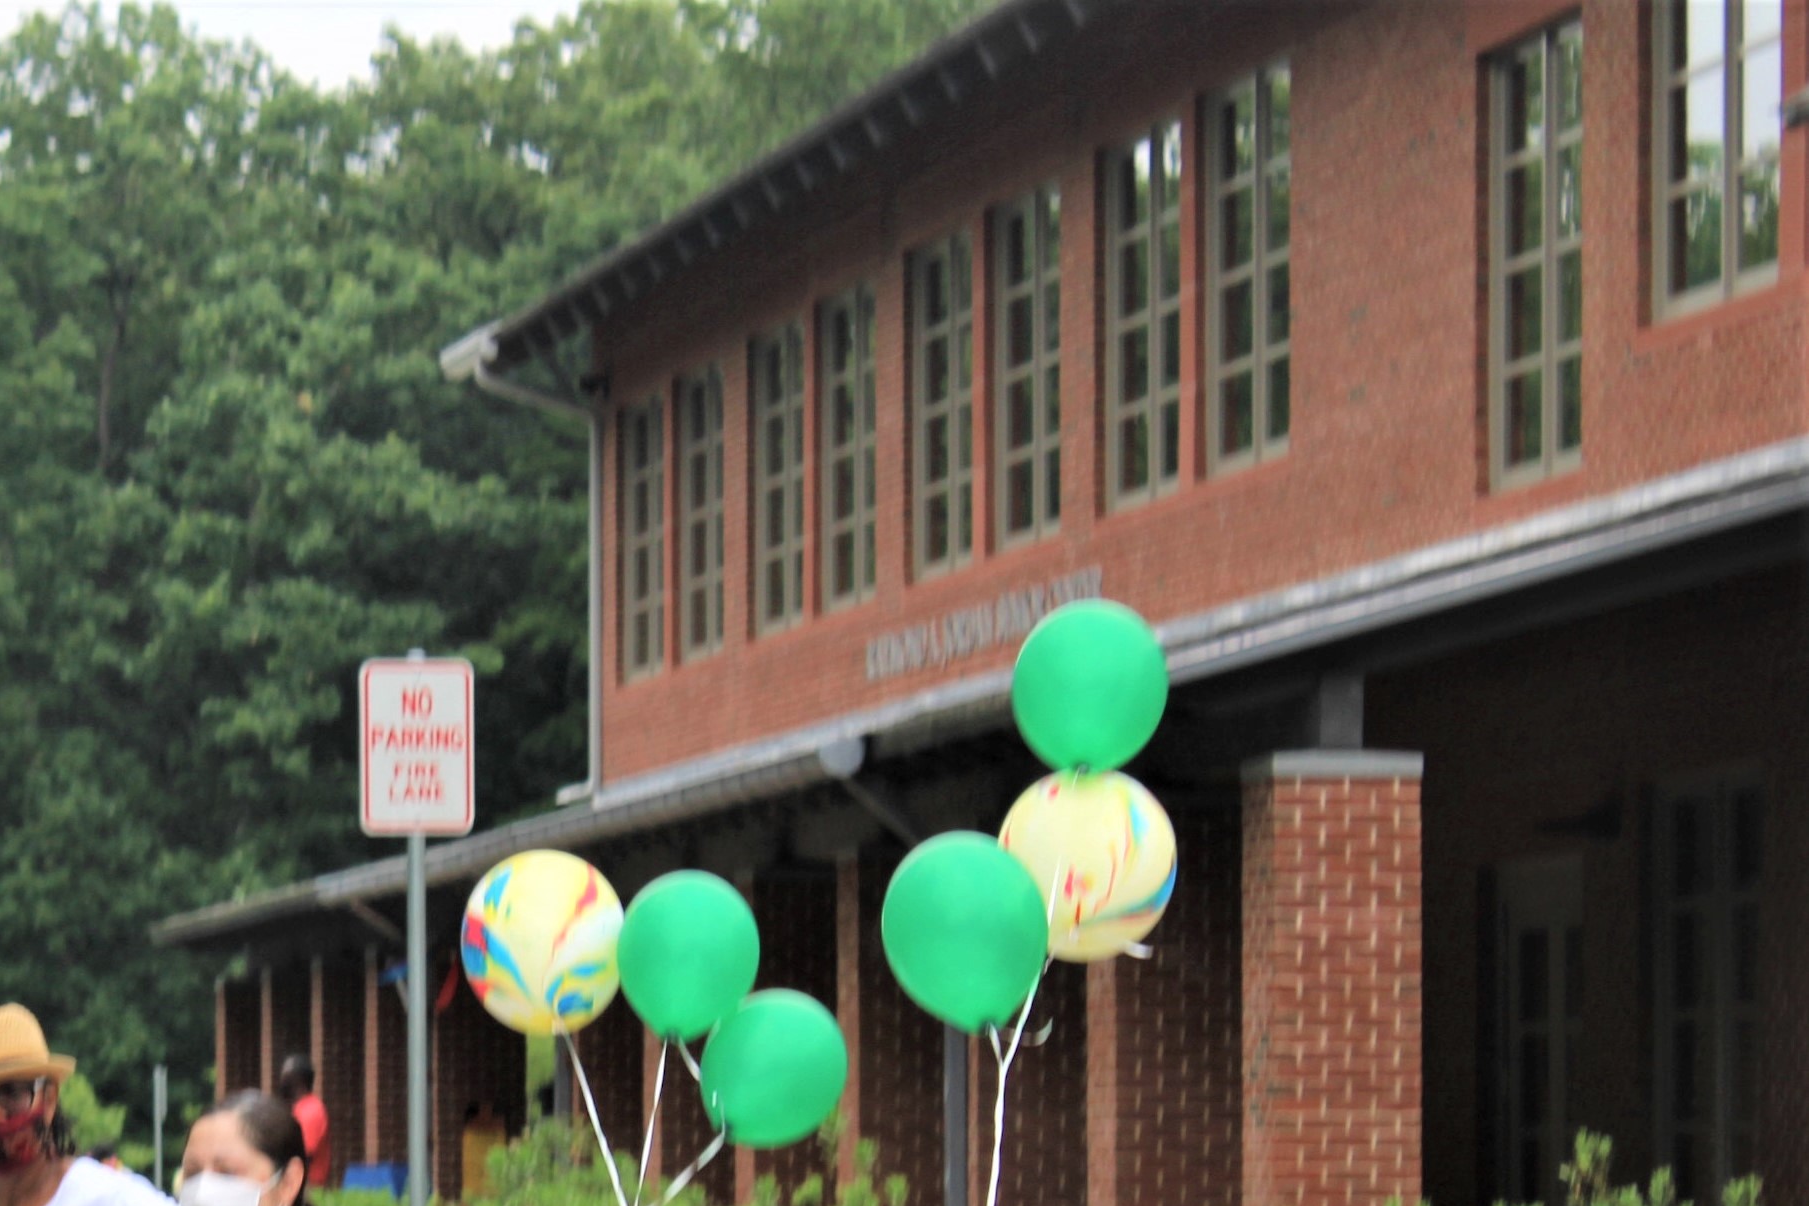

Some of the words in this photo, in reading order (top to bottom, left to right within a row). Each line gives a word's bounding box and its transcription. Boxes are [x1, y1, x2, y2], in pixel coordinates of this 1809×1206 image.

[401, 687, 433, 718] NO
[371, 724, 465, 752] PARKING
[393, 760, 440, 781] FIRE
[389, 780, 444, 802] LANE
